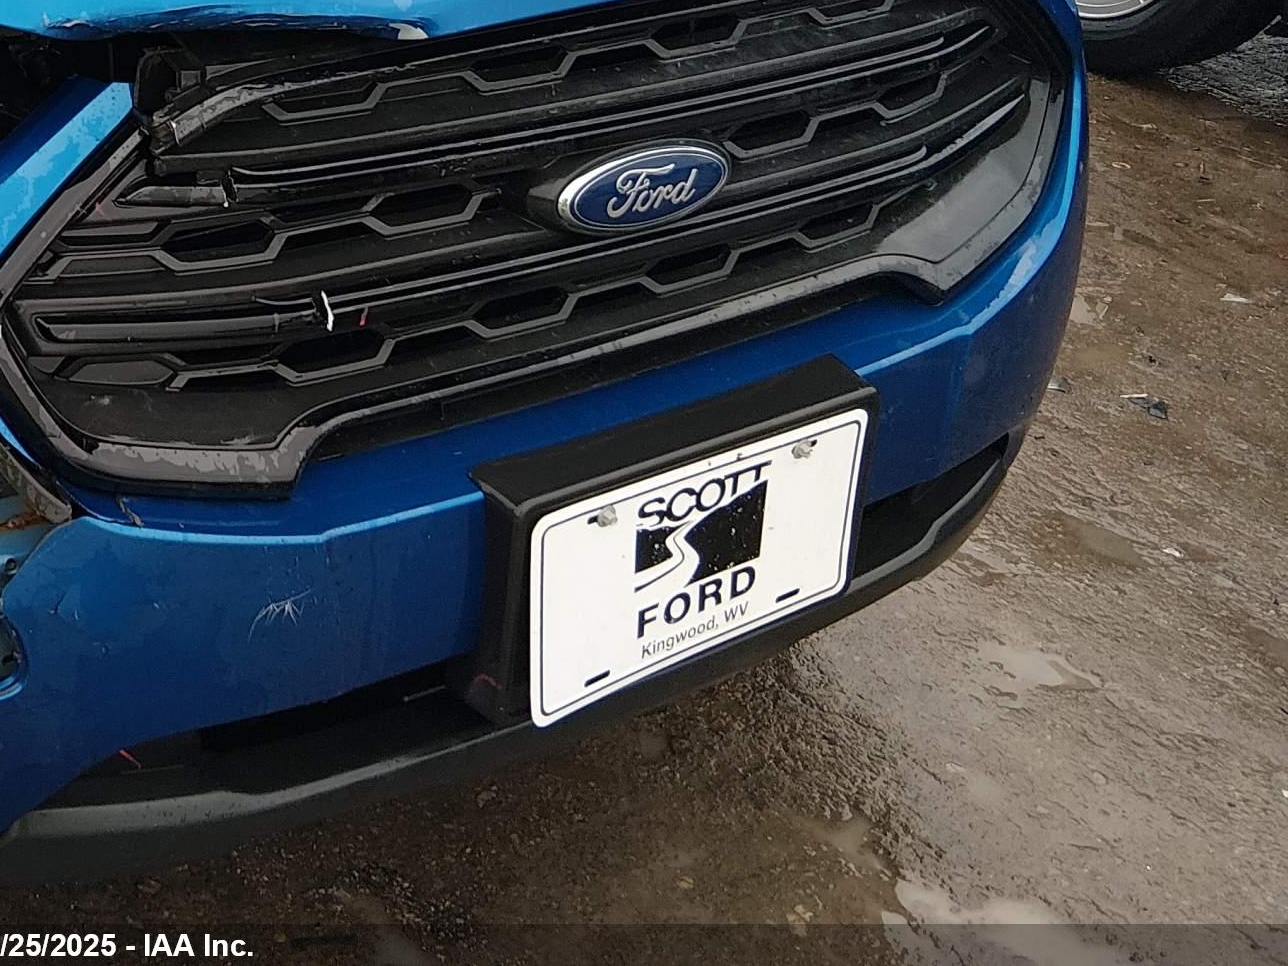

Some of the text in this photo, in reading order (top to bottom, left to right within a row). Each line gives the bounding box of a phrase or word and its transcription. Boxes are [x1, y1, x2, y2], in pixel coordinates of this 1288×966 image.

[607, 163, 699, 218] Ford
[637, 461, 772, 527] SCOTT
[638, 566, 755, 638] FORD
[641, 602, 749, 658] Kingwood, WV
